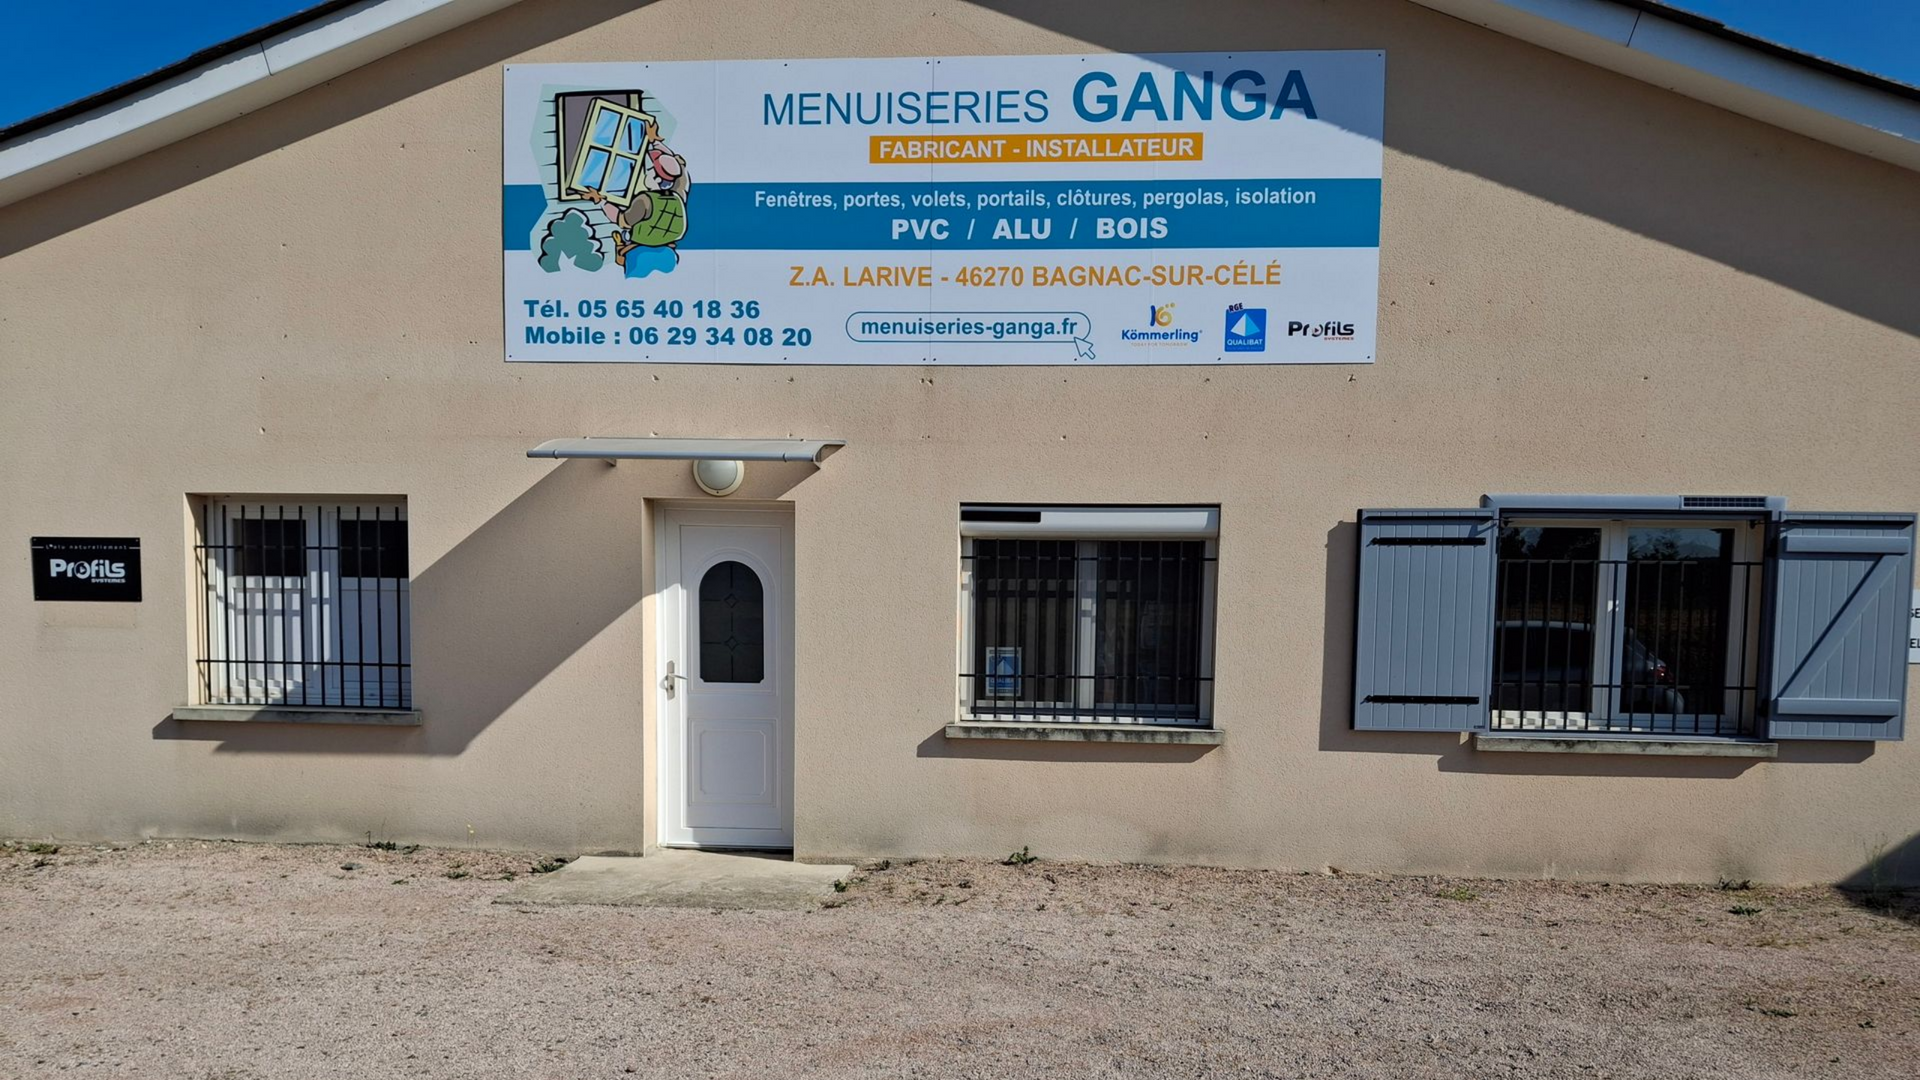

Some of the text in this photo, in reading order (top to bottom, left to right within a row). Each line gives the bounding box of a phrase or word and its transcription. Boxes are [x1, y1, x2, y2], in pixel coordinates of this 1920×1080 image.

[764, 70, 1318, 125] MENUISERIES GANGA
[879, 140, 1006, 159] FABRICANT
[1026, 138, 1193, 157] INSTALLATEUR
[755, 187, 1316, 211] Fenêtres, portes, volets, portails, clôtures, pergolas, isolation
[892, 219, 949, 240] PVC
[992, 218, 1051, 239] ALU
[1097, 217, 1168, 239] BOIS
[789, 266, 834, 286] Z.A.
[844, 266, 932, 287] LARIVE
[955, 265, 1024, 286] 46270
[1032, 260, 1281, 286] BAGNAC-SUR-CÉLÉ
[524, 300, 760, 319] Tél. 05 65 40 18 36
[1228, 302, 1244, 312] RGE
[525, 326, 605, 345] Mobile
[629, 327, 658, 345] 06
[667, 327, 696, 345] 29
[706, 327, 735, 345] 34
[744, 328, 773, 346] 08
[782, 328, 812, 346] 20
[862, 318, 1077, 338] menuiseries-ganga.fr
[1288, 321, 1355, 337] Profils
[1226, 338, 1264, 346] QUALIBAT
[50, 558, 126, 579] Profils
